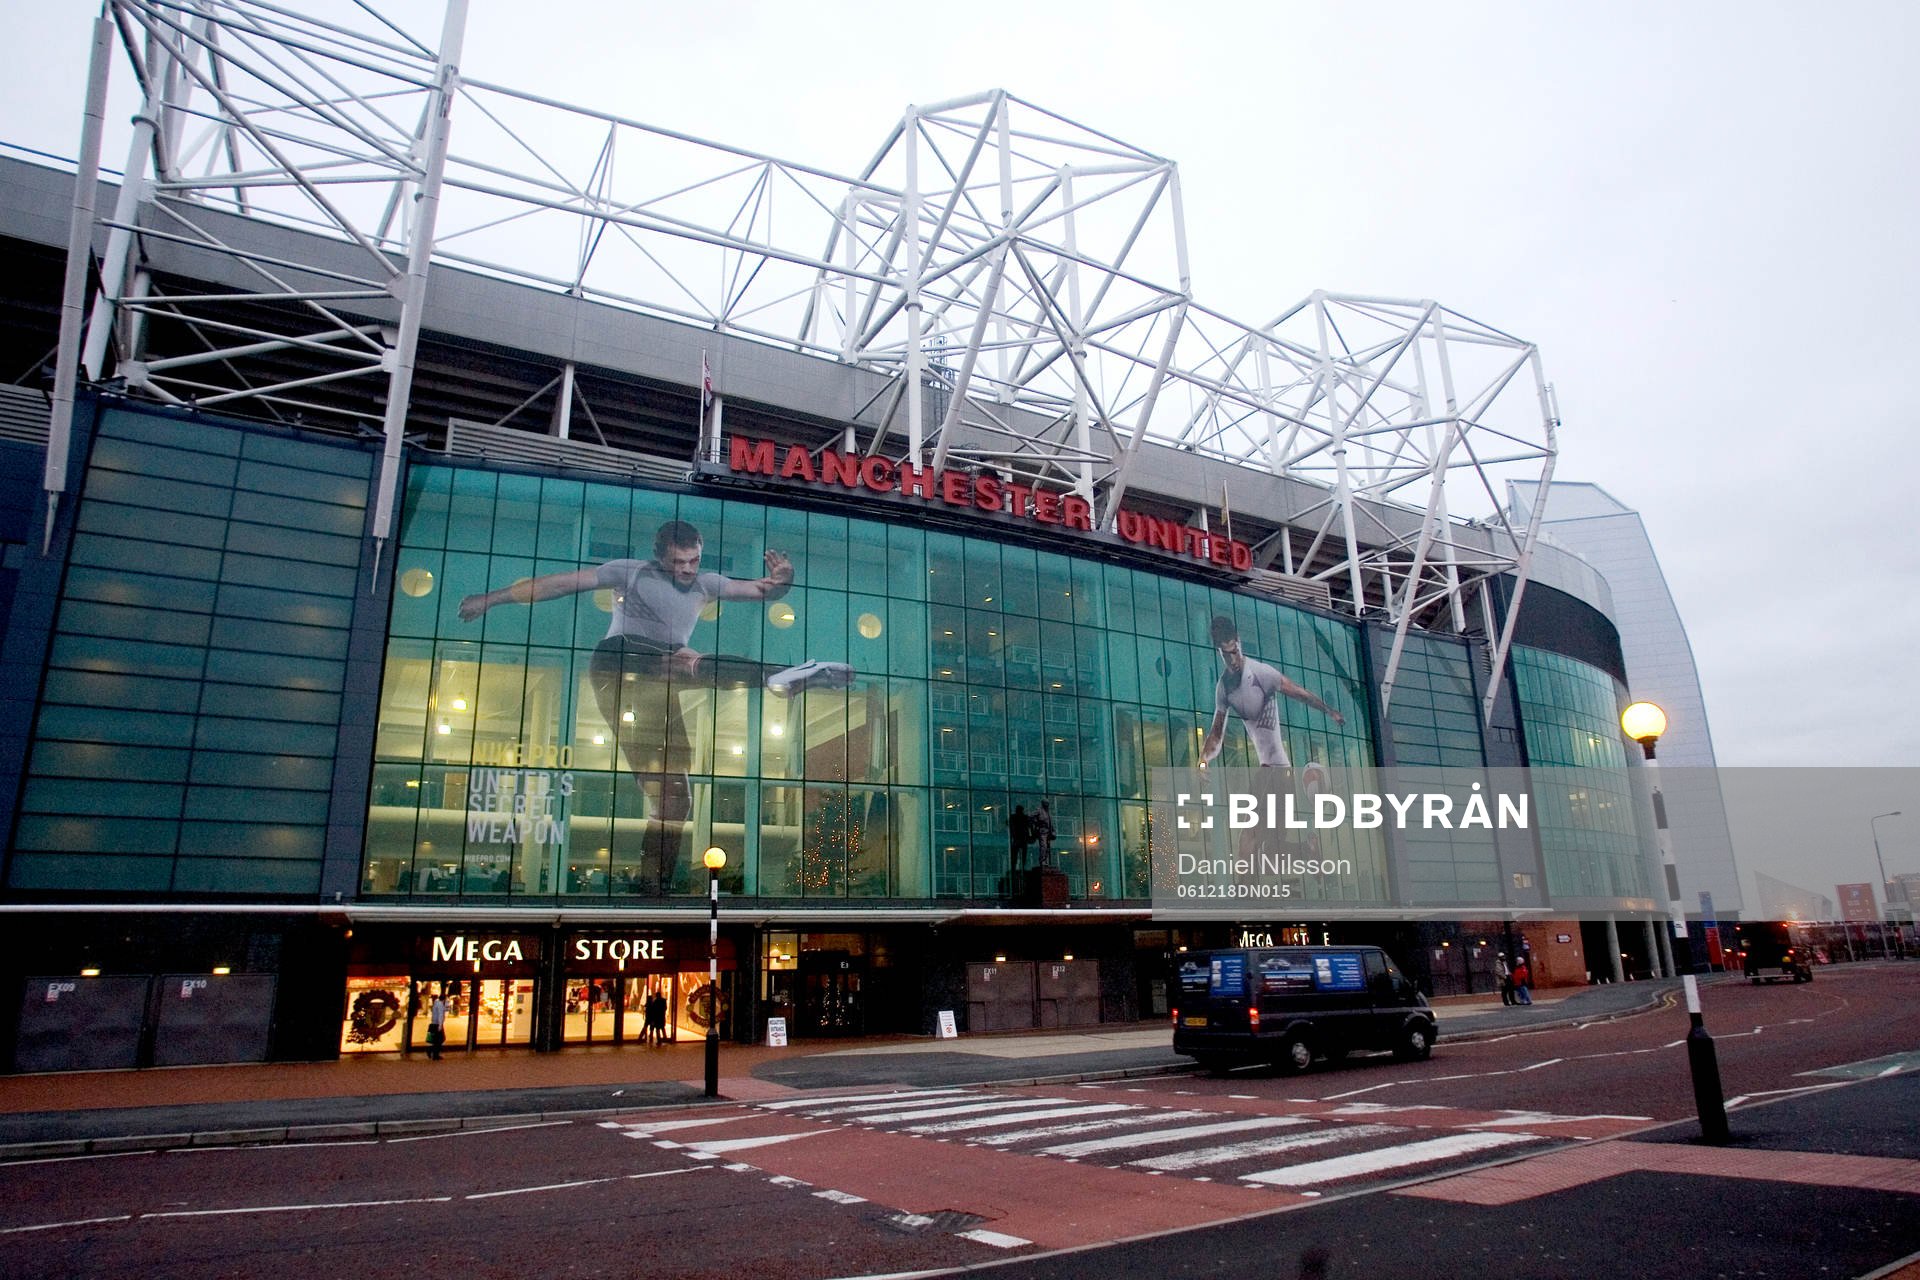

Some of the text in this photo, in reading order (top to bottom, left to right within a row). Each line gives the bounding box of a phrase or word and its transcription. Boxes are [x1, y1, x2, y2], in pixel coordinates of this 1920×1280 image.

[730, 434, 1254, 571] MANCHESTER UNITED
[528, 744, 573, 769] PRO
[471, 768, 574, 797] UNITED'S
[469, 793, 555, 820] SECRET
[467, 817, 565, 845] WEAPON
[575, 939, 664, 960] STORE
